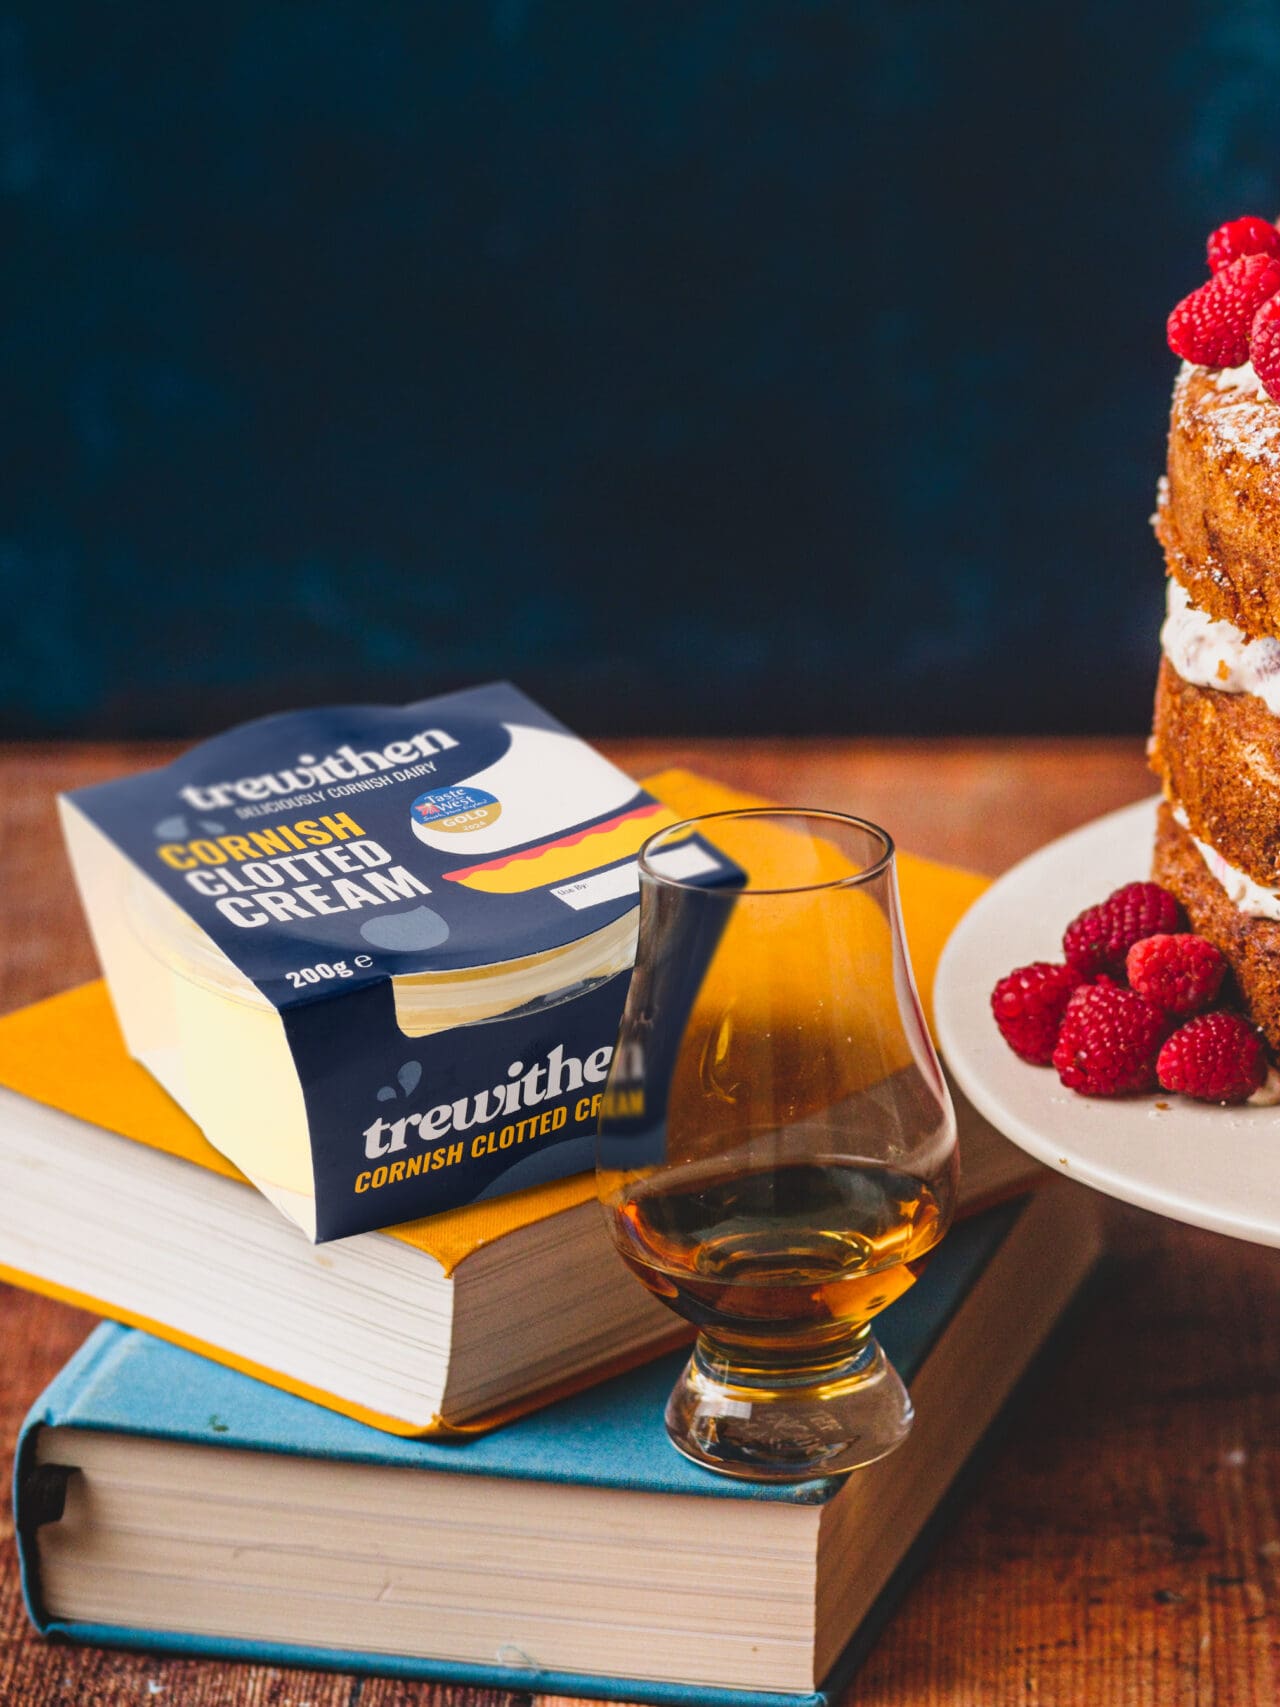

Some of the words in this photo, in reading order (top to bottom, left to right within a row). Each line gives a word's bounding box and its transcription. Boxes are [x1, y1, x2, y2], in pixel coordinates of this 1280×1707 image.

[180, 728, 460, 811] trewithen
[236, 790, 327, 820] DELICIOUSLY
[327, 774, 393, 799] CORNISH
[394, 760, 438, 784] DAIRY
[424, 788, 466, 804] Taste
[434, 795, 475, 812] West
[442, 809, 488, 827] GOLD
[158, 811, 367, 871] CORNISH
[184, 839, 393, 897] CLOTTED
[214, 865, 433, 929] CREAM
[285, 960, 354, 989] 200g
[354, 1141, 464, 1194] CORNISH
[470, 1105, 567, 1158] CLOTTED
